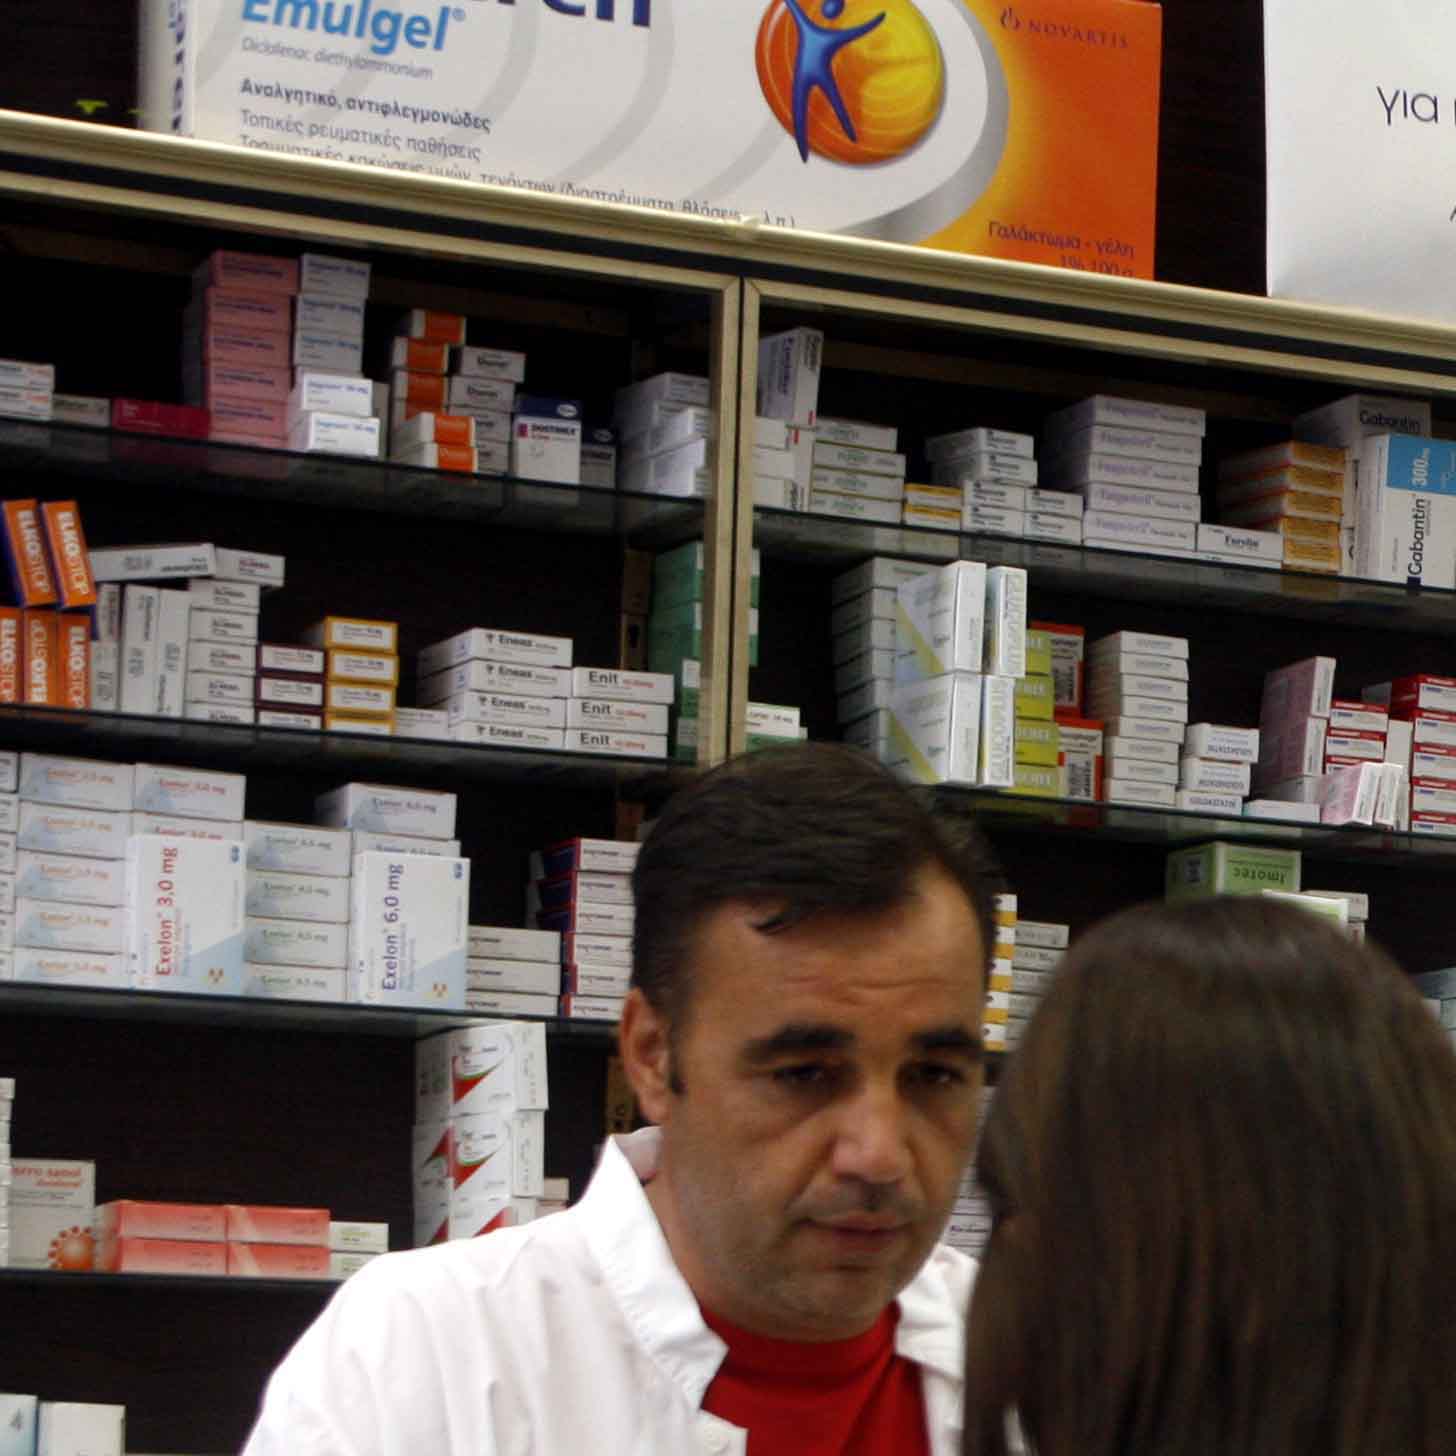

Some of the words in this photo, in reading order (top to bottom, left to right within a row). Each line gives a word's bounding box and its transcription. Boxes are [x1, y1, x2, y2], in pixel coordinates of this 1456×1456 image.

[1030, 21, 1128, 49] NOVARTIS
[1377, 86, 1439, 126] για
[1407, 496, 1426, 576] Gabantin
[588, 671, 618, 685] Enit
[580, 702, 612, 716] Enit
[580, 733, 610, 746] Enit
[162, 847, 179, 874] mg
[389, 863, 405, 891] mg
